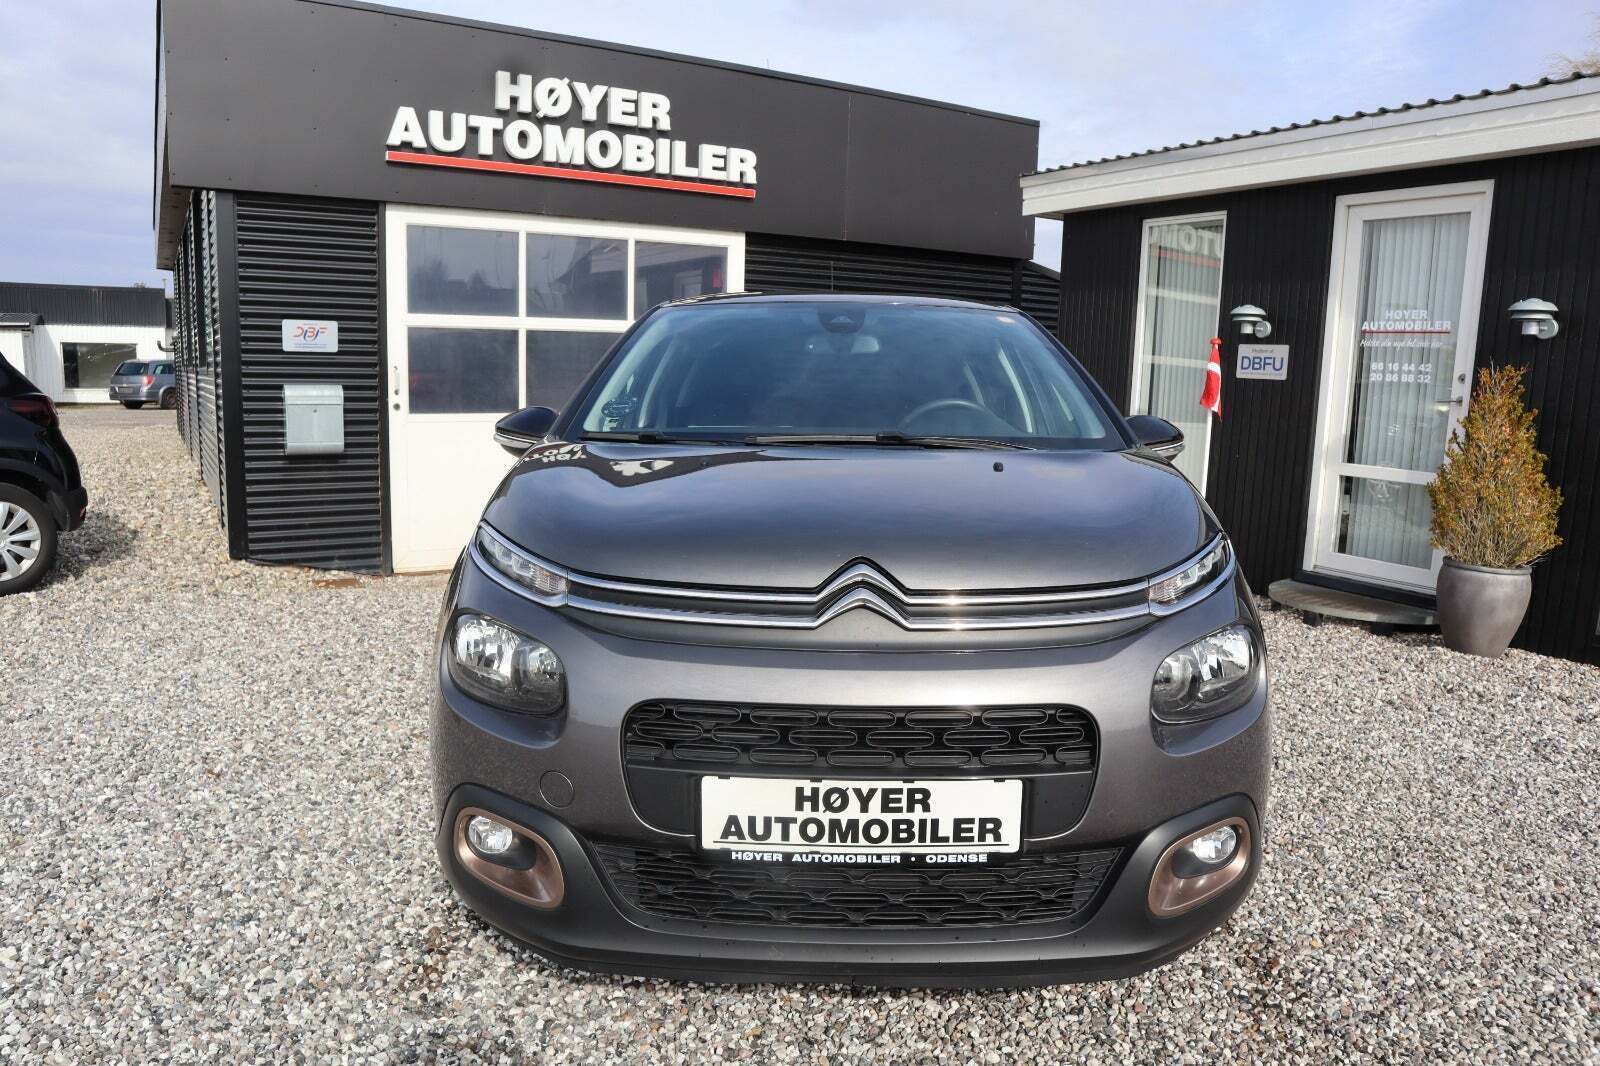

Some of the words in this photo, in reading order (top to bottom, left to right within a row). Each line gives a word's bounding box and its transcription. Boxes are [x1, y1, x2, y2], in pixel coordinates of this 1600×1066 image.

[495, 70, 671, 131] HØYER
[386, 106, 757, 184] AUTOMOBILER
[1361, 320, 1452, 331] AUTOMOBILER
[1241, 356, 1284, 371] DBFU
[1387, 362, 1399, 371] 16
[1401, 363, 1415, 372] 44
[1418, 363, 1432, 373] 42
[1370, 373, 1383, 381] 20
[1417, 374, 1431, 384] 32
[795, 786, 932, 814] HØYER
[720, 814, 1003, 844] AUTOMOBILER
[731, 851, 783, 862] HØYER
[791, 854, 901, 864] AUTOMOBILER
[925, 854, 988, 863] ODENSE
